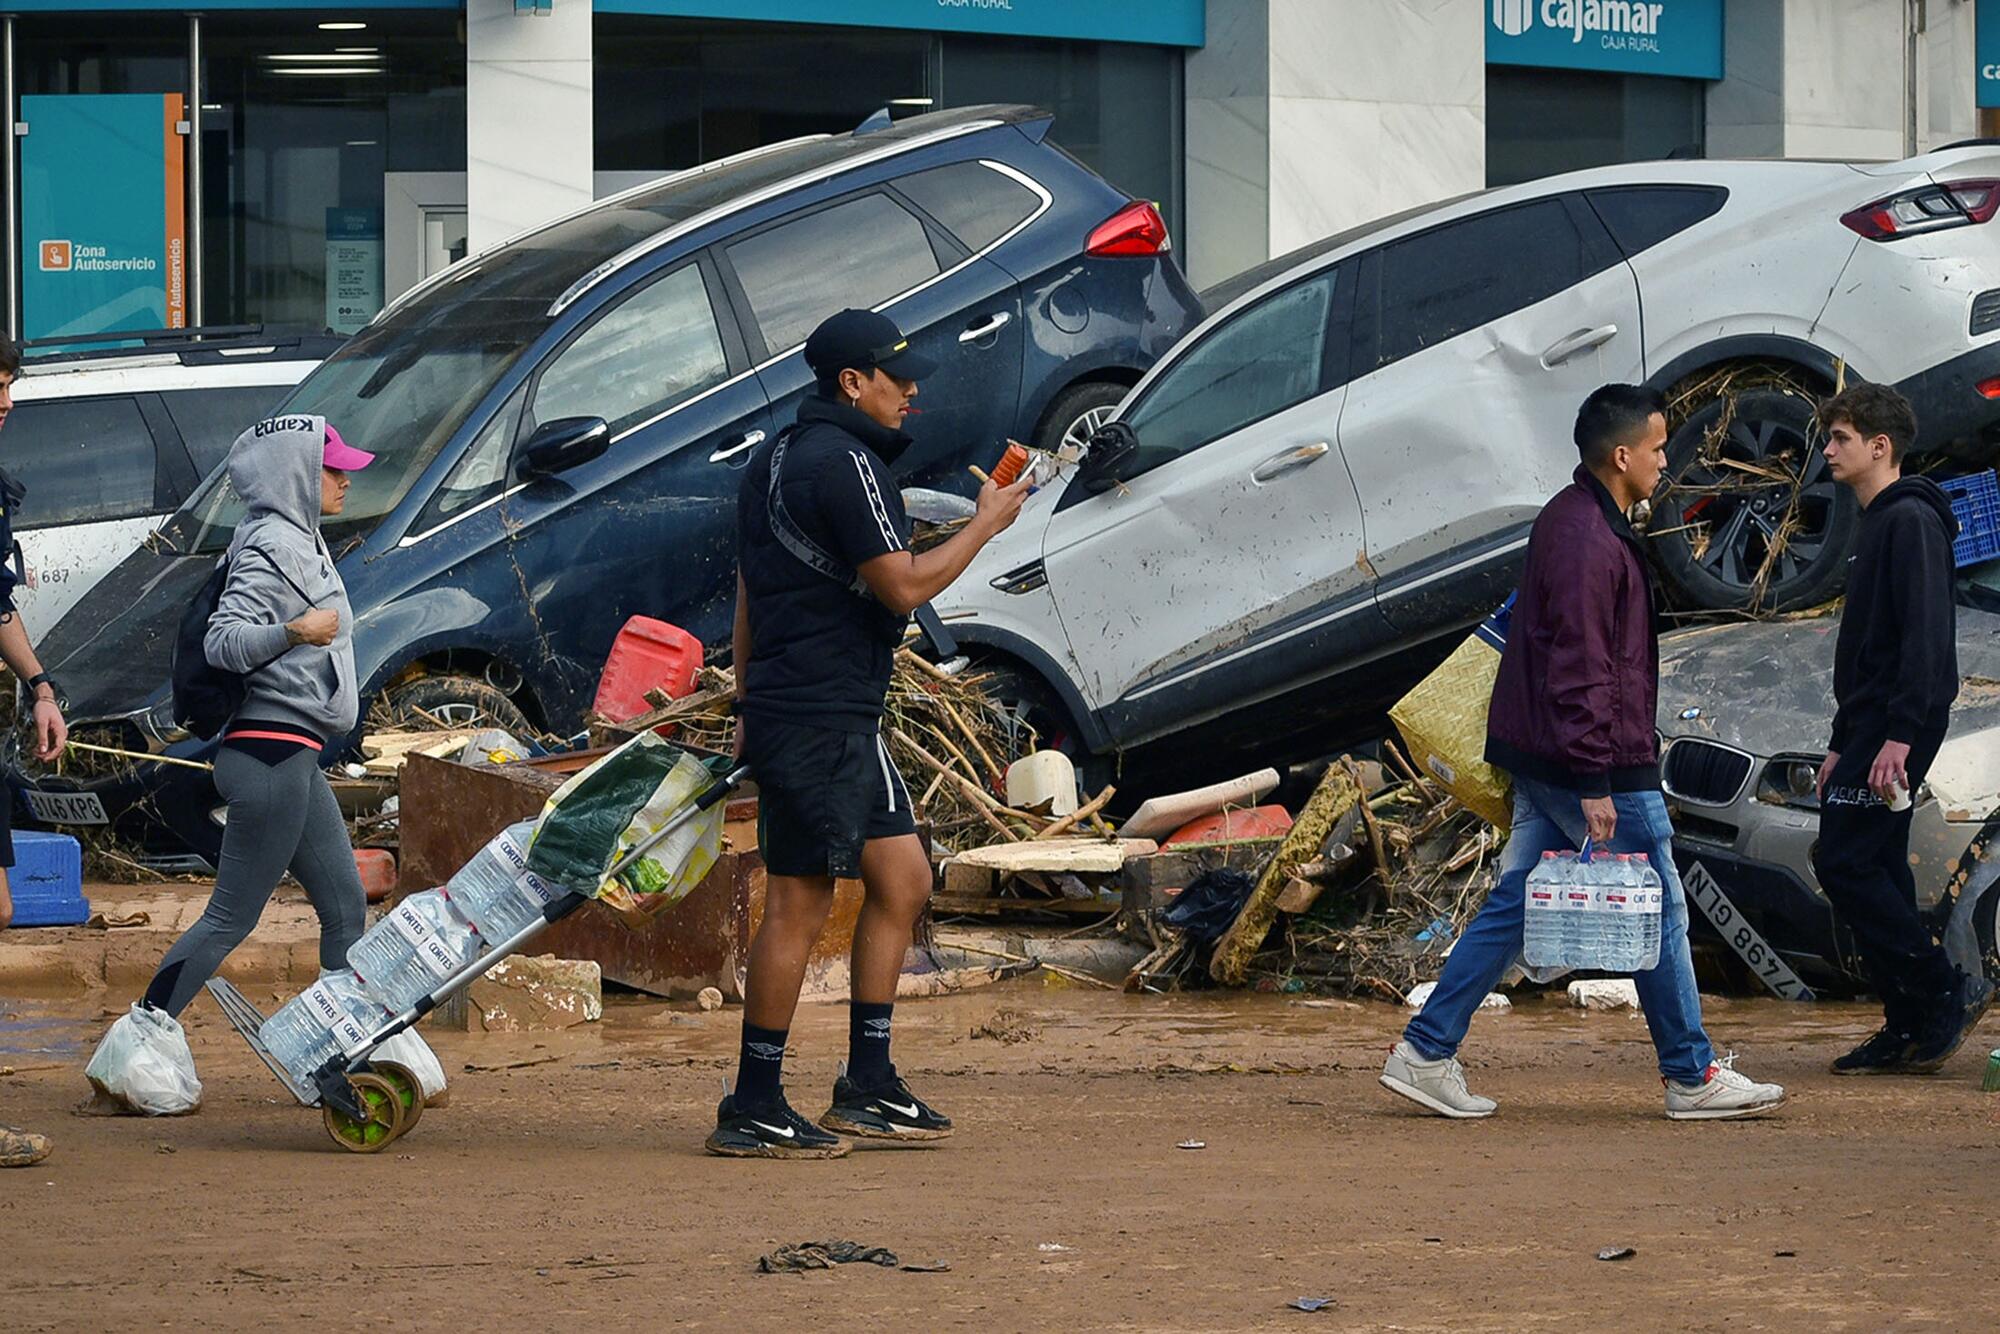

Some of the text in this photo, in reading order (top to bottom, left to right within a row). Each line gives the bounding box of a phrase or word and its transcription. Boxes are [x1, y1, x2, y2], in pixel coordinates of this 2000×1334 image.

[1540, 0, 1663, 43] cajamar
[1601, 34, 1661, 53] CAJA RURAL
[74, 244, 106, 258] Zona
[74, 257, 156, 271] Autoservicio
[169, 238, 182, 329] ona Autoservicio
[254, 418, 315, 438] Kappa
[41, 568, 70, 584] 687
[65, 797, 102, 820] KPG
[500, 840, 524, 870] CORTES
[526, 874, 551, 902] CORTES
[400, 907, 425, 936] CORTES
[1688, 870, 1797, 996] 7498 GLN
[428, 942, 454, 971] CORTES
[312, 990, 338, 1020] CORTES
[342, 1022, 364, 1044] CORT
